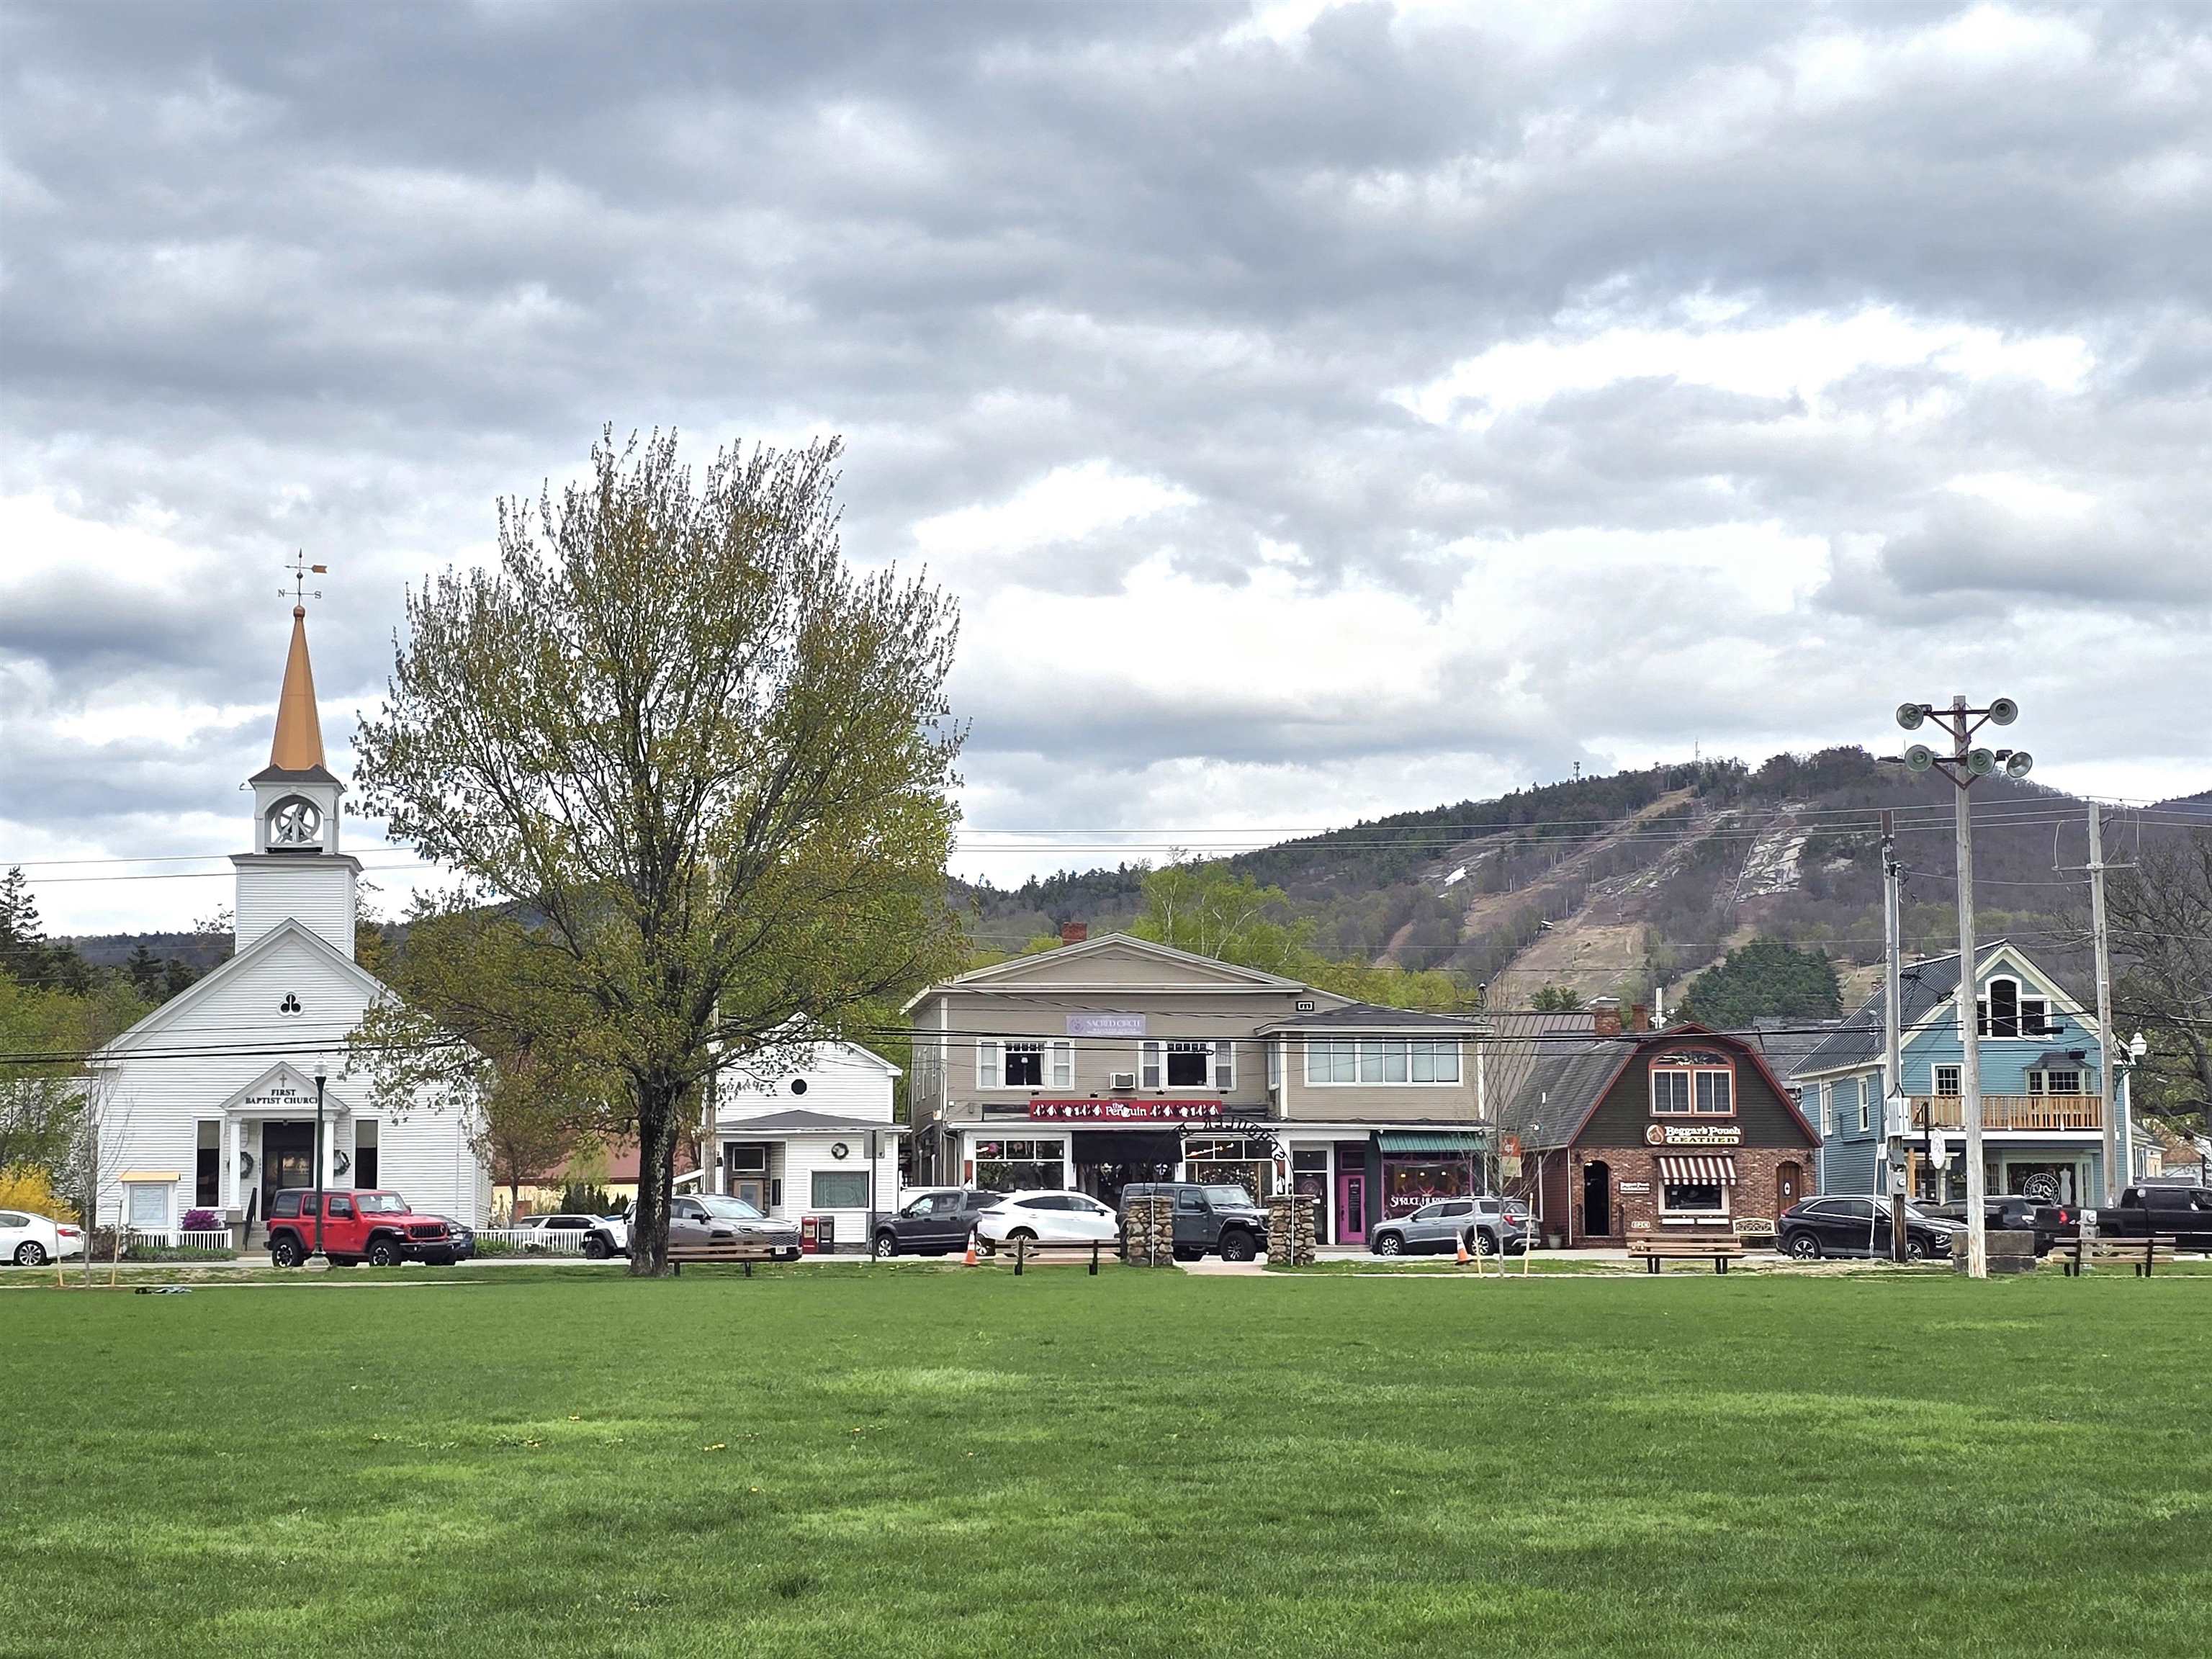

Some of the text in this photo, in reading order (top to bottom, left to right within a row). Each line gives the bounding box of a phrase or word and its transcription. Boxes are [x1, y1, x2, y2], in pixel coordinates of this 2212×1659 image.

[277, 588, 285, 598] N
[314, 590, 322, 599] S
[1664, 1125, 1741, 1136] Beggar's Pouch
